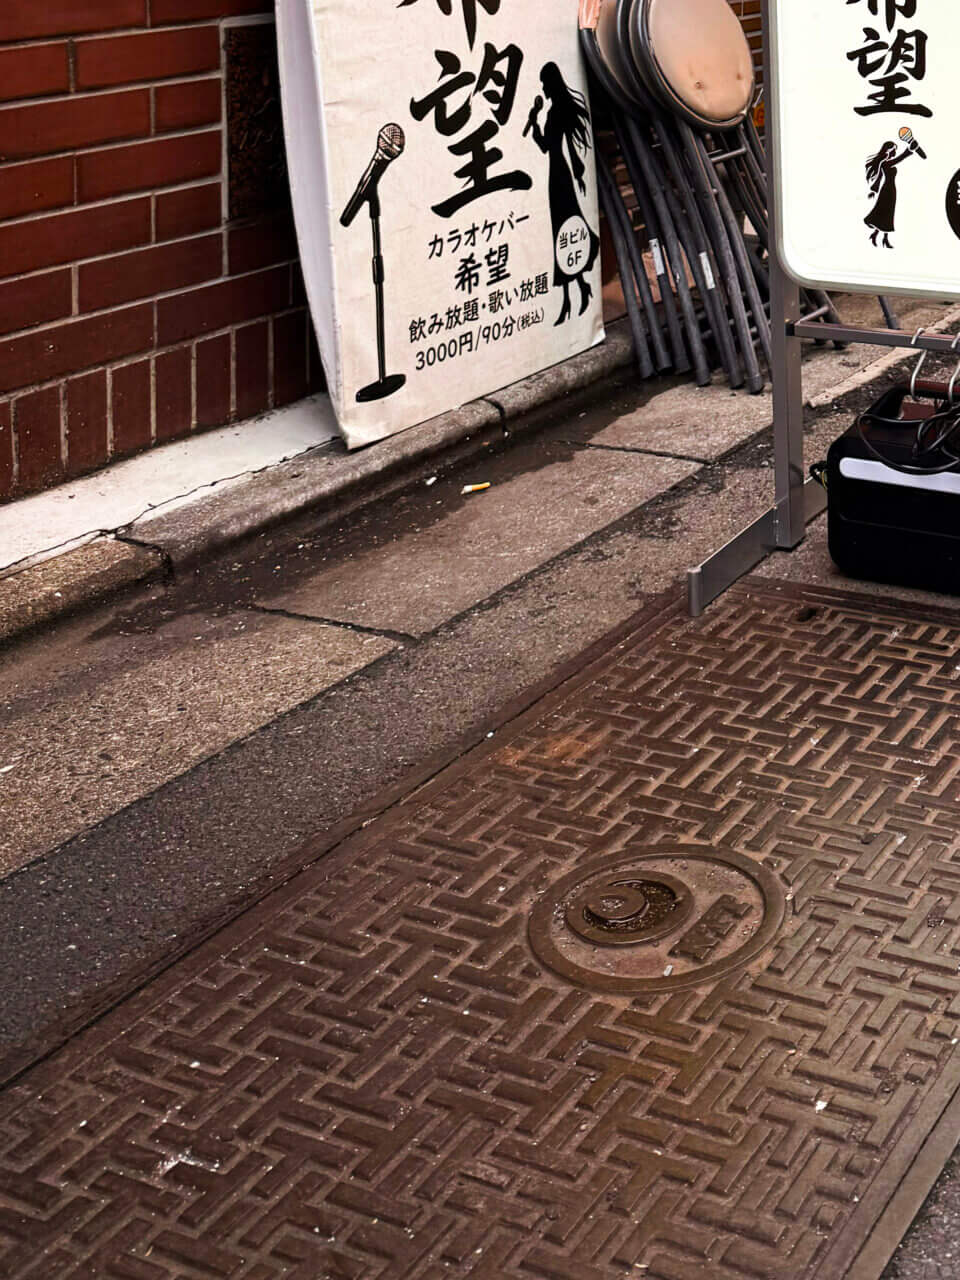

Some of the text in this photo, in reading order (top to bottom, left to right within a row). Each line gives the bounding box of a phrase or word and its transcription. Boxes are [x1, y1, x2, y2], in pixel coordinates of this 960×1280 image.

[428, 211, 530, 260] カラオケバー
[559, 227, 588, 250] 当ビル
[454, 243, 511, 295] 希望
[566, 250, 583, 268] 6F
